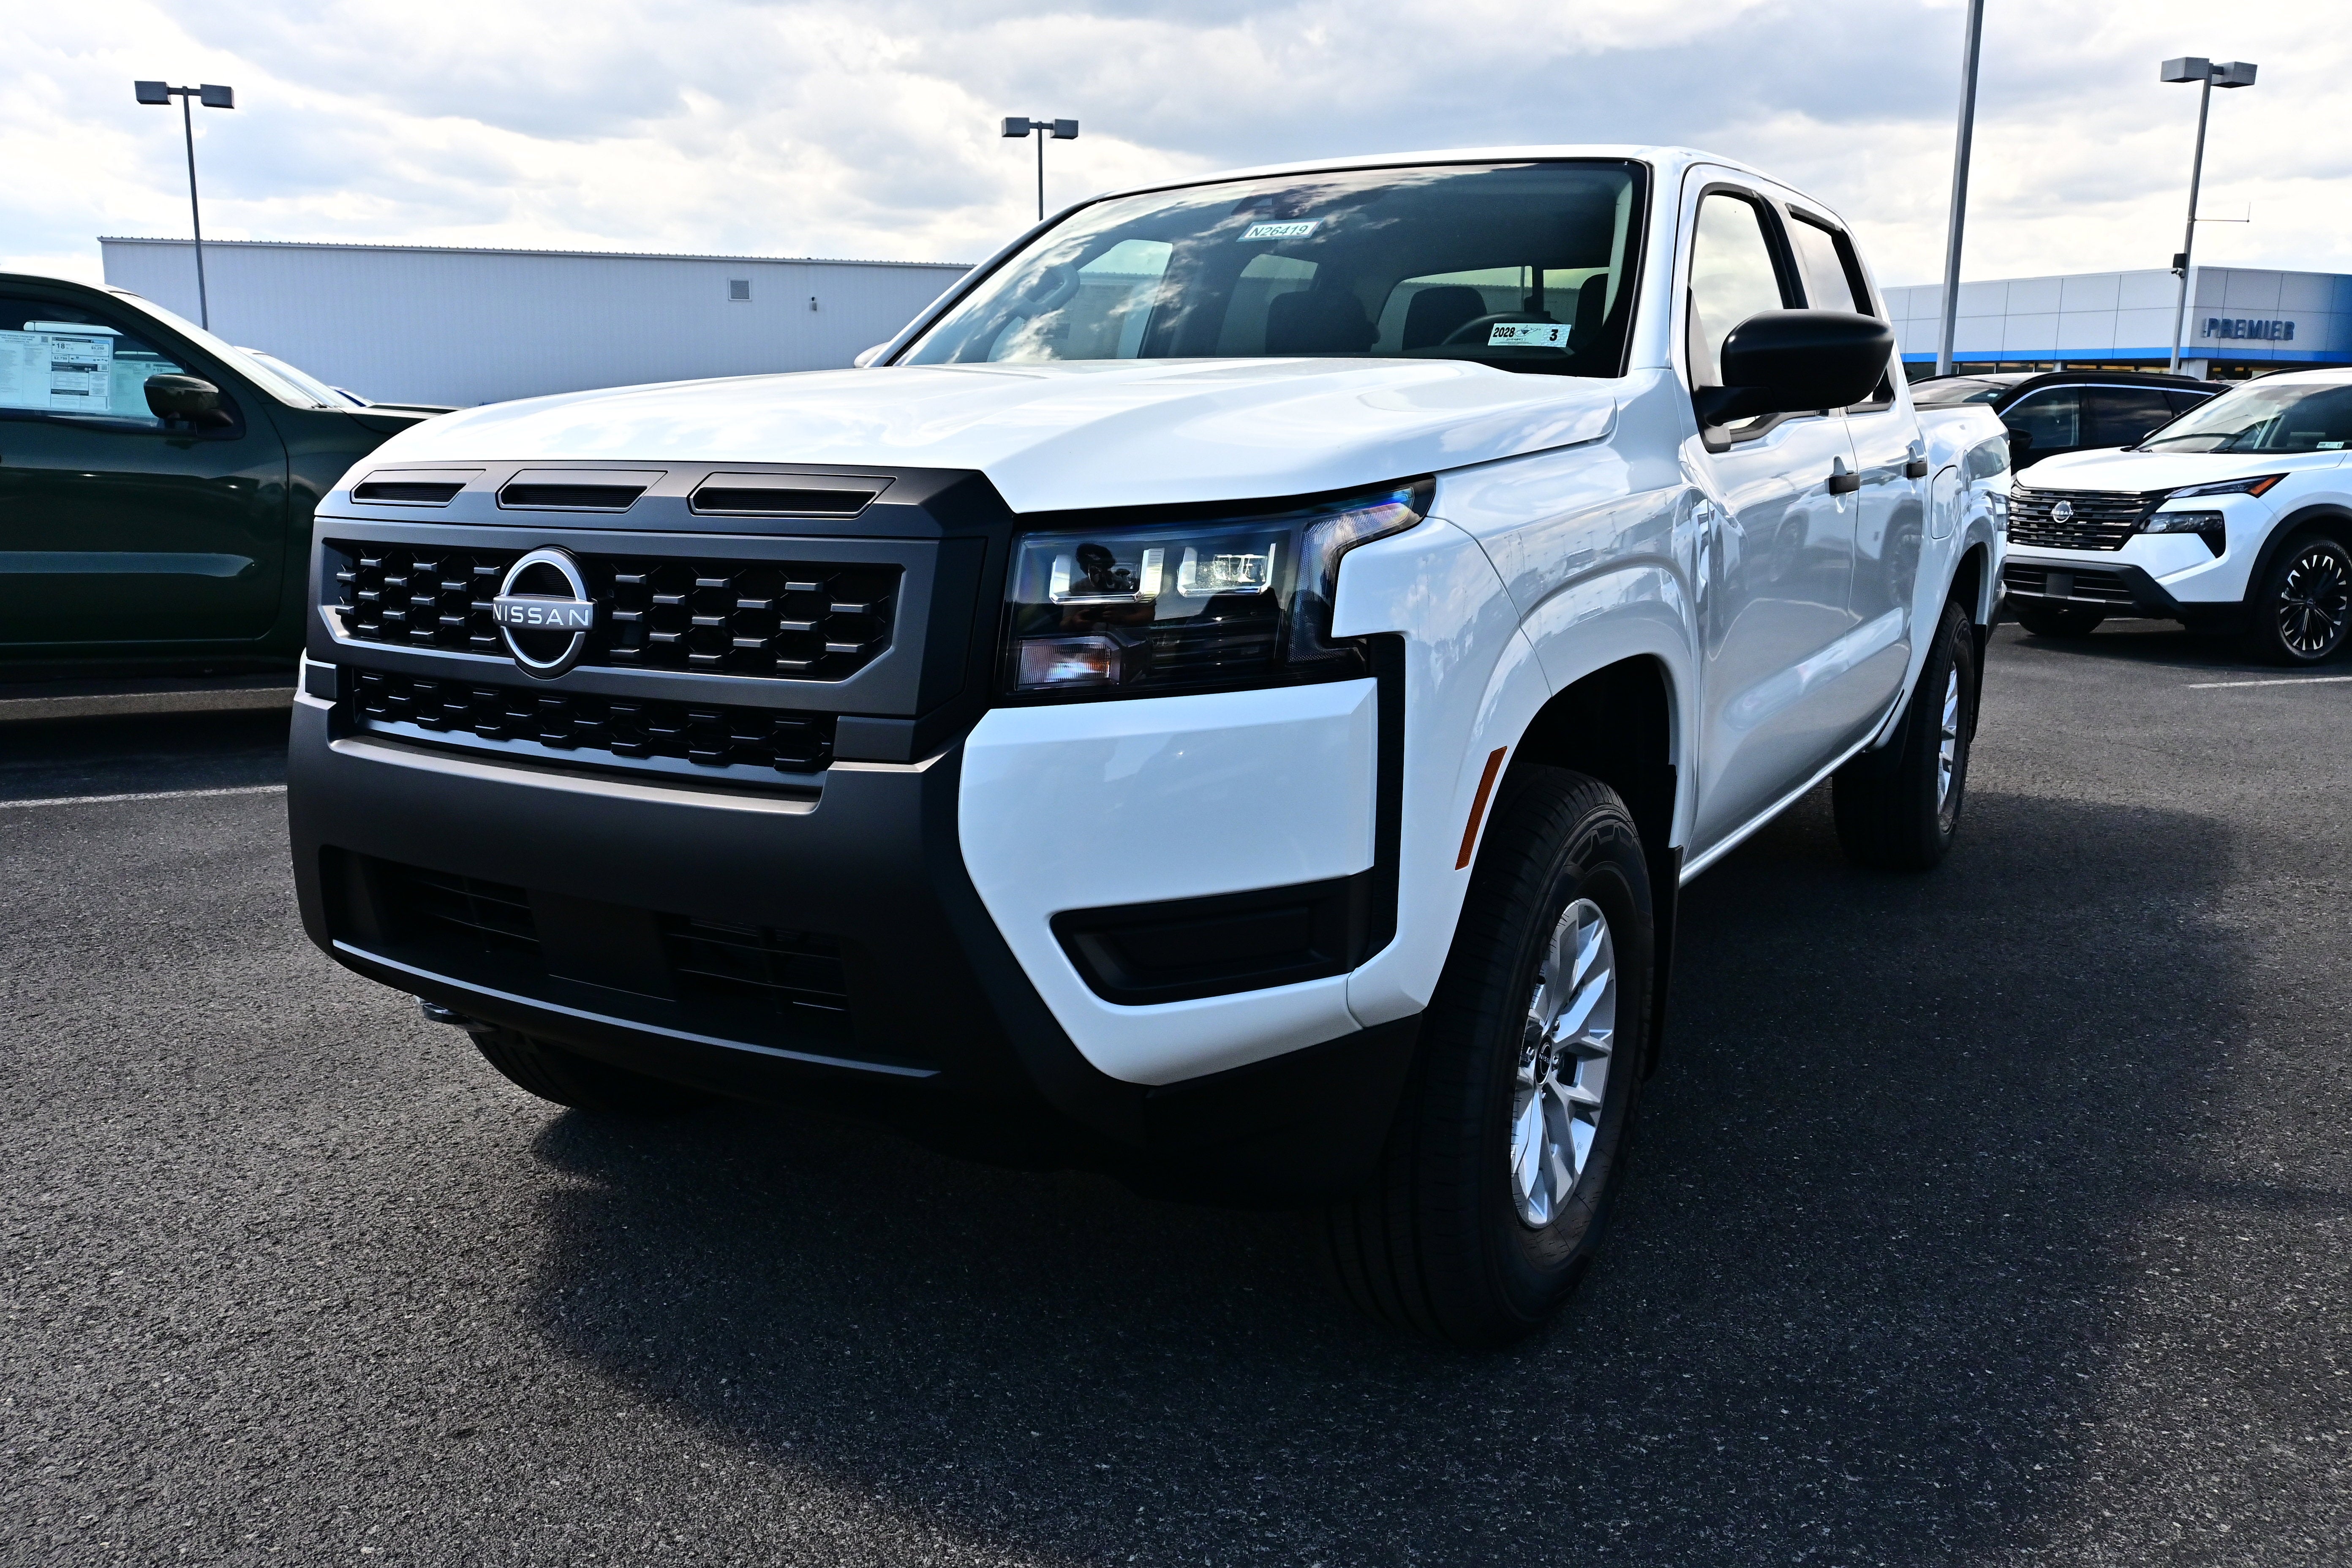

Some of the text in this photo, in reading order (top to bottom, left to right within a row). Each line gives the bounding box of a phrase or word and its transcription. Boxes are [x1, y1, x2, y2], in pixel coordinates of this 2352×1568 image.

[1249, 225, 1309, 237] N26419
[1492, 327, 1559, 341] 2028 3
[2205, 318, 2295, 340] PREMIER
[493, 603, 589, 626] NISSAN
[1539, 1053, 1551, 1064] NISS
